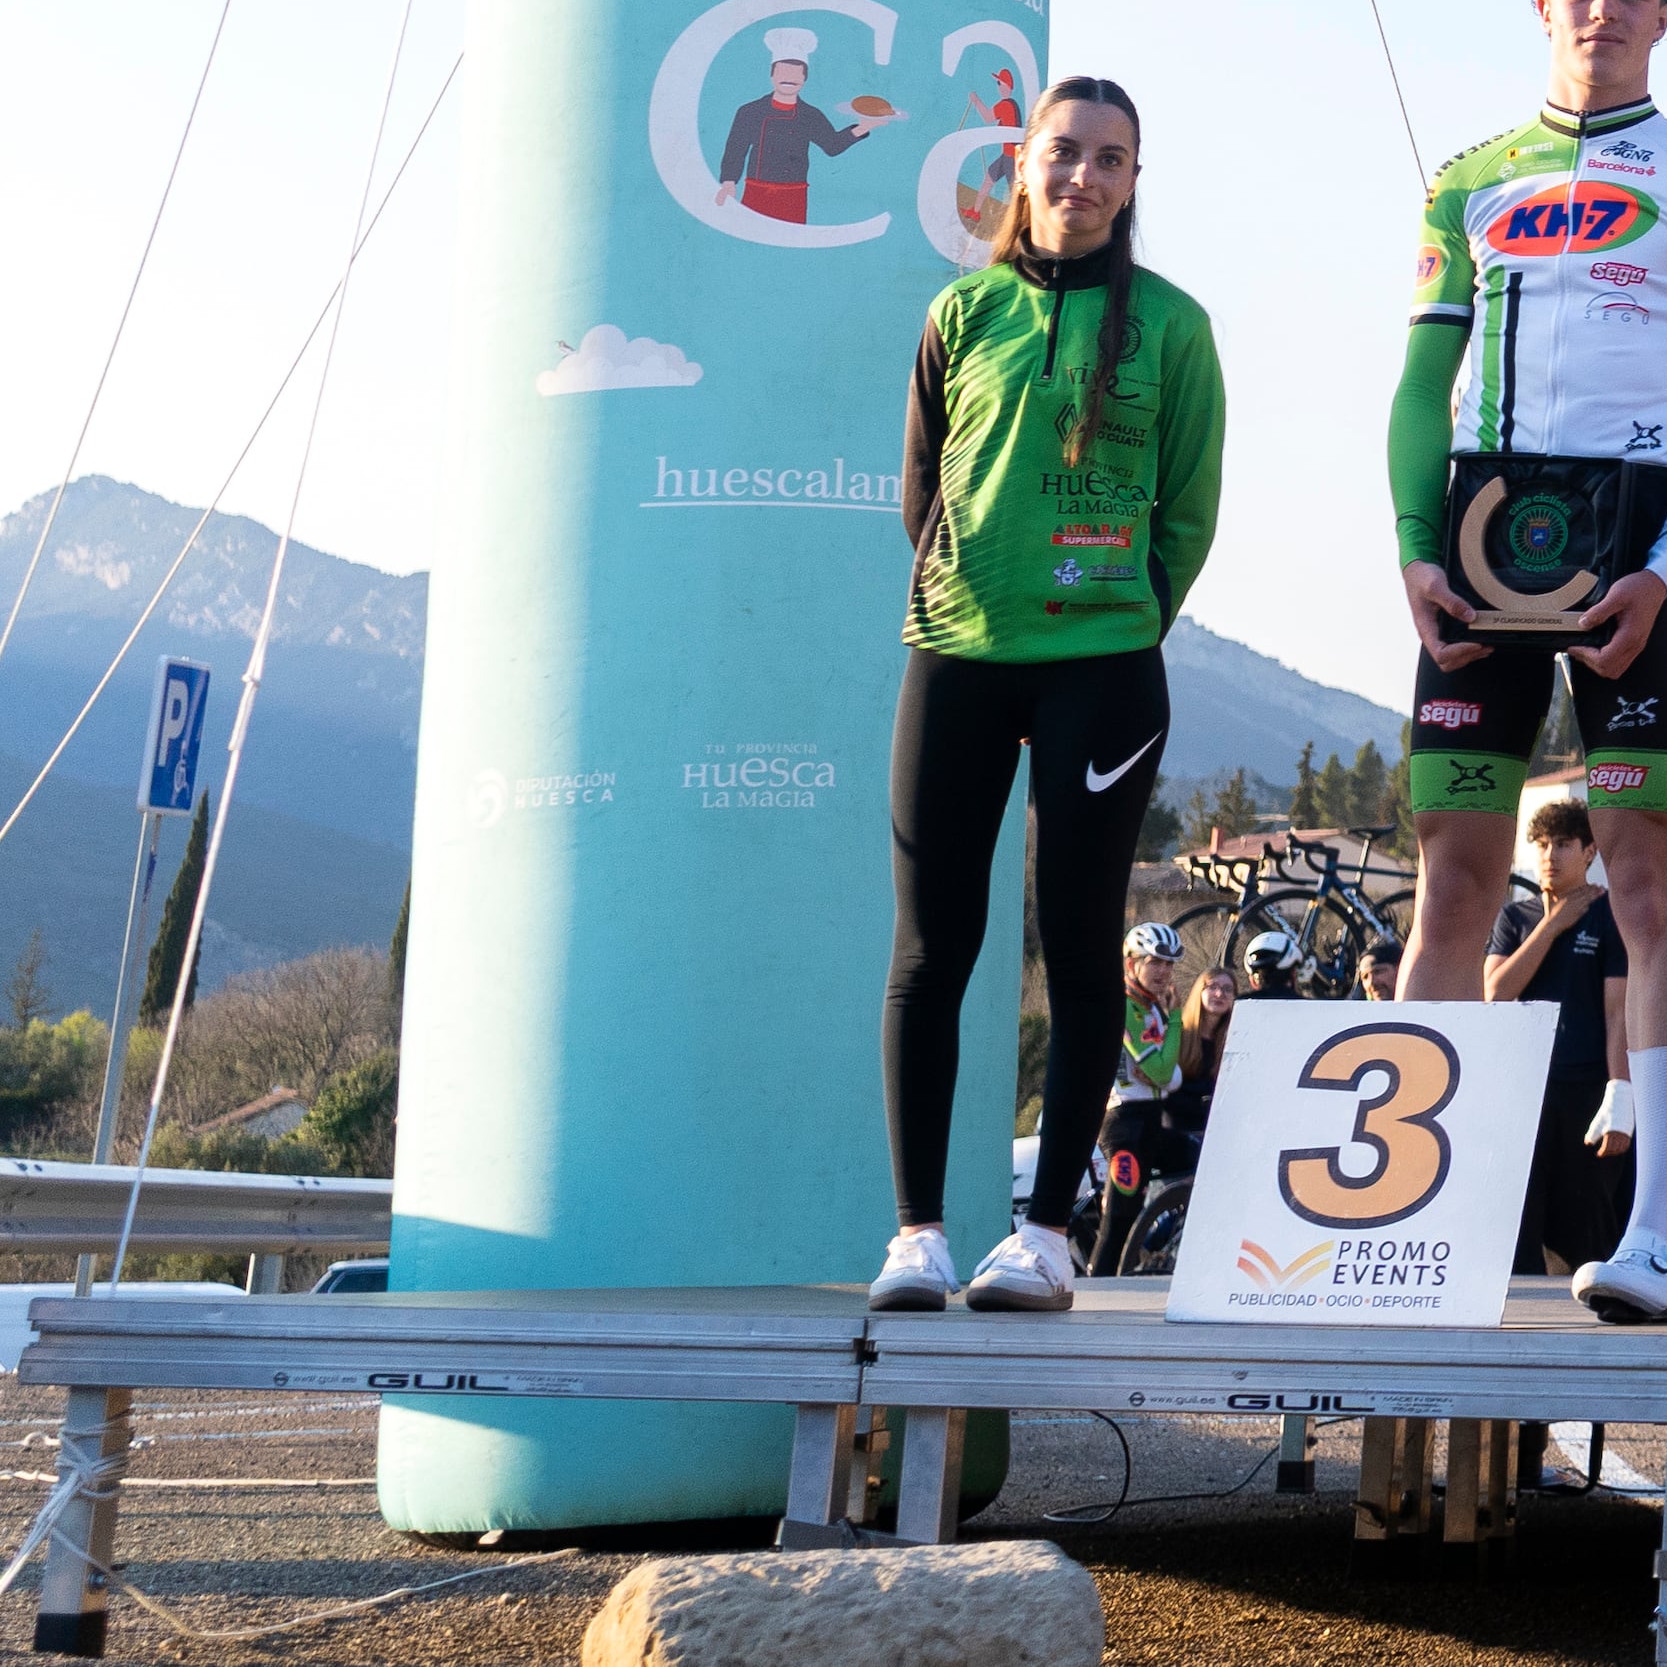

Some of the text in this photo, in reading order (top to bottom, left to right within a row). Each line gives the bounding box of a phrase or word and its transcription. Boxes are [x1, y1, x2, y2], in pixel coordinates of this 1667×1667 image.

[1587, 159, 1645, 175] Barcelona
[1040, 470, 1150, 502] Huesca
[157, 679, 190, 768] P
[515, 769, 616, 794] DIPUTACIÓN
[681, 757, 837, 789] Huesca
[514, 788, 615, 810] HUESCA
[1278, 1021, 1461, 1230] 3
[1337, 1240, 1452, 1262] PROMO
[1333, 1264, 1448, 1287] EVENTS
[1229, 1293, 1442, 1309] PUBLICIDAD OCIO DEPORTE
[366, 1372, 510, 1391] GUIL
[1226, 1394, 1377, 1412] GUIL
